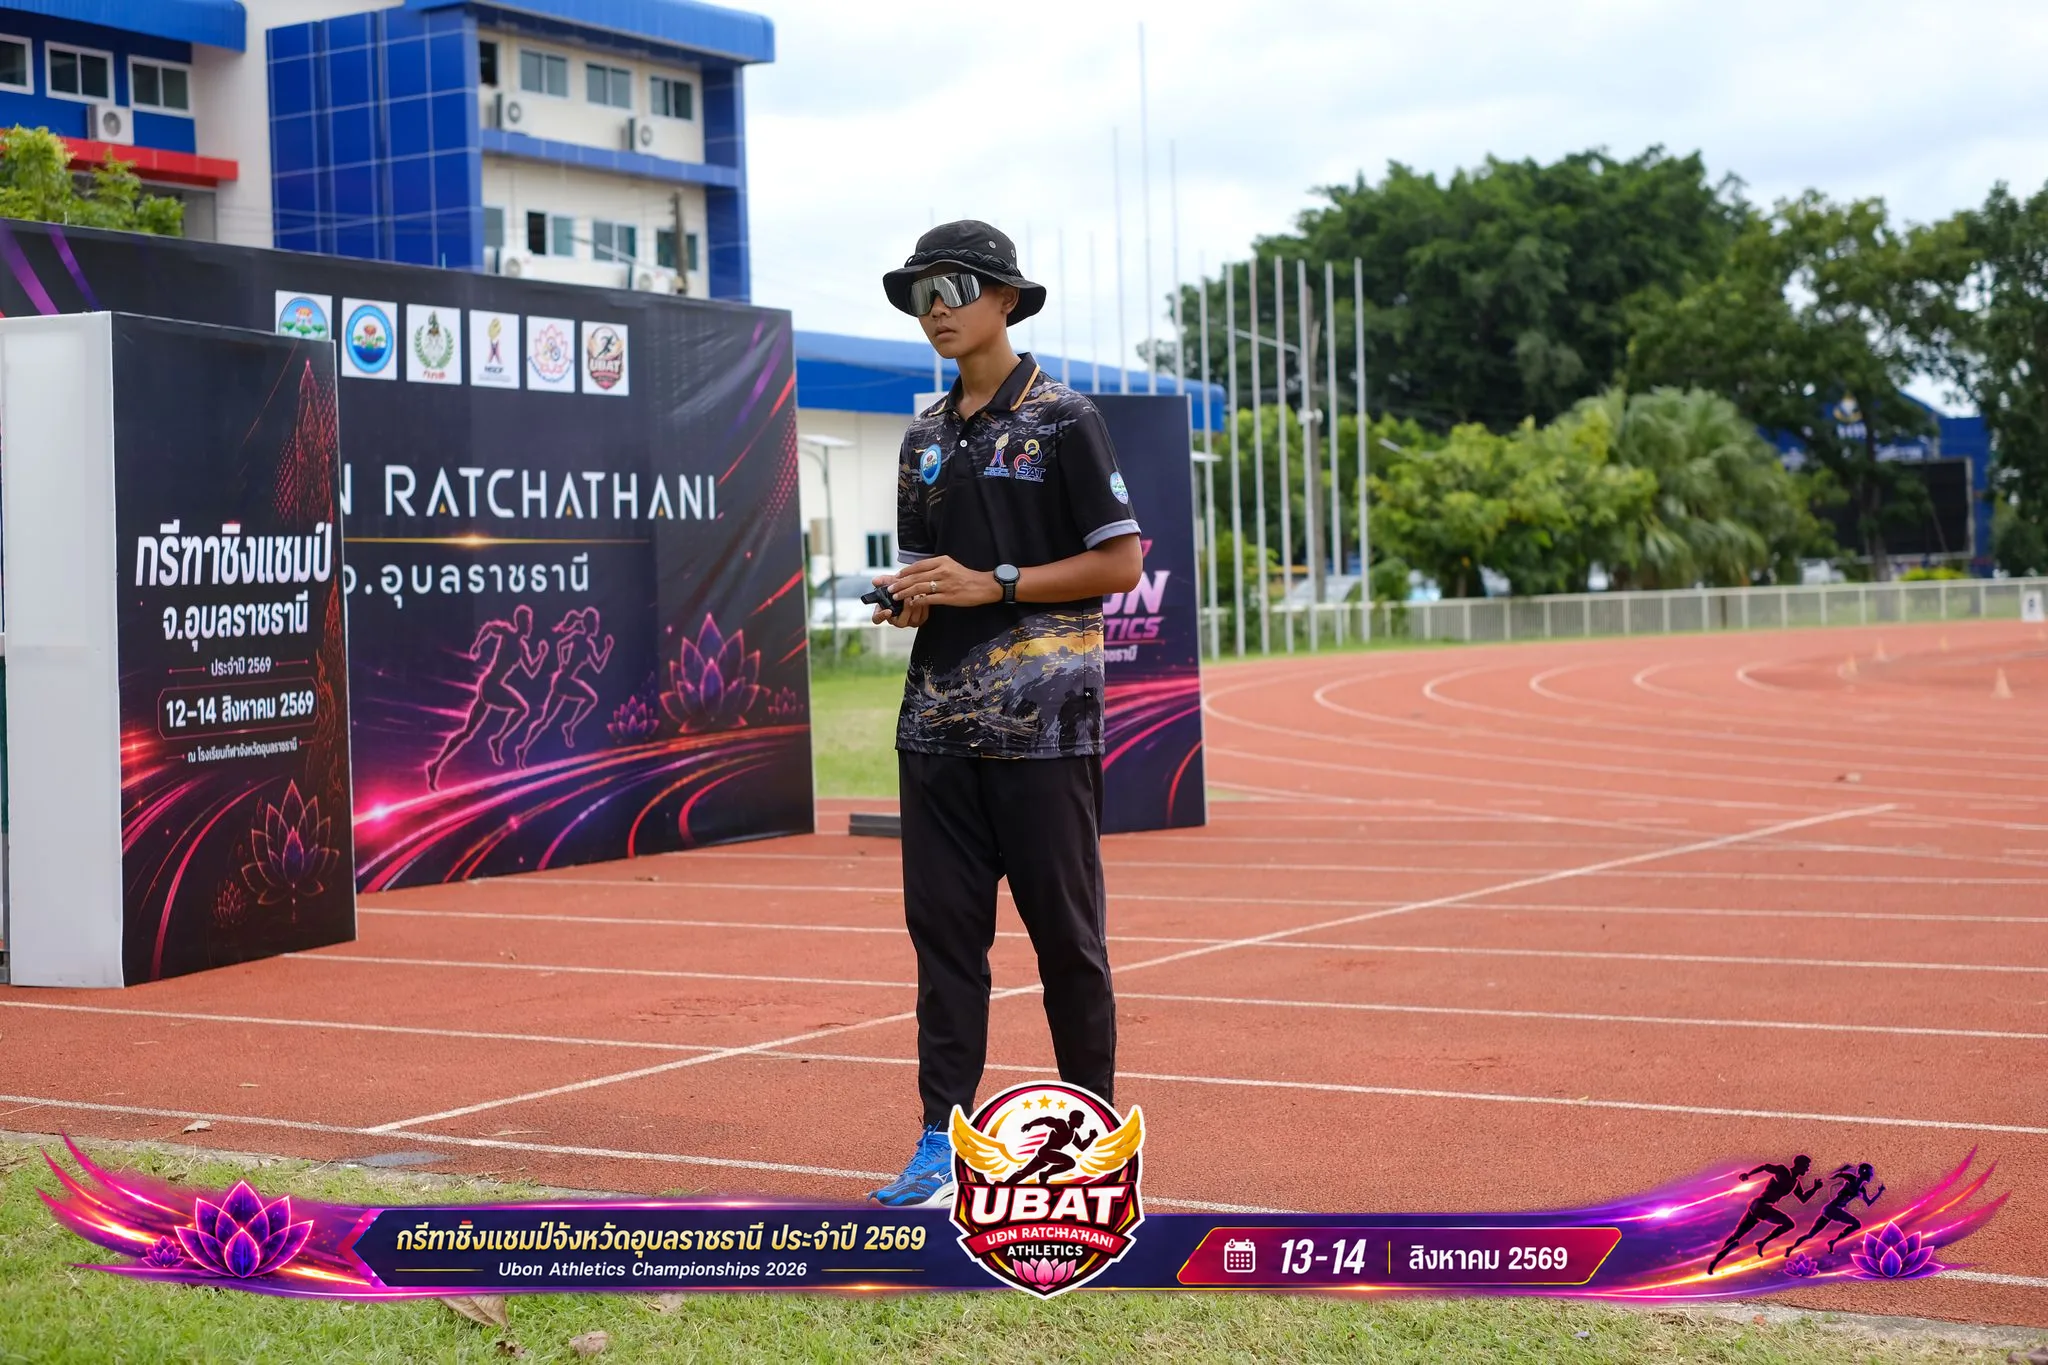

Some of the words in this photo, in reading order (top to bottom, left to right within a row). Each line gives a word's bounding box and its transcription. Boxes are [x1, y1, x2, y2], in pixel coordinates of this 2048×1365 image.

[385, 464, 716, 520] RATCHATHANI
[135, 519, 333, 587] กรีฑาชิงแชมป์
[163, 590, 309, 652] จ.อุบลราชธานี
[211, 656, 245, 676] ประจำปี
[248, 656, 271, 674] 2569
[222, 695, 276, 723] สิงหาคม
[280, 690, 314, 717] 2569
